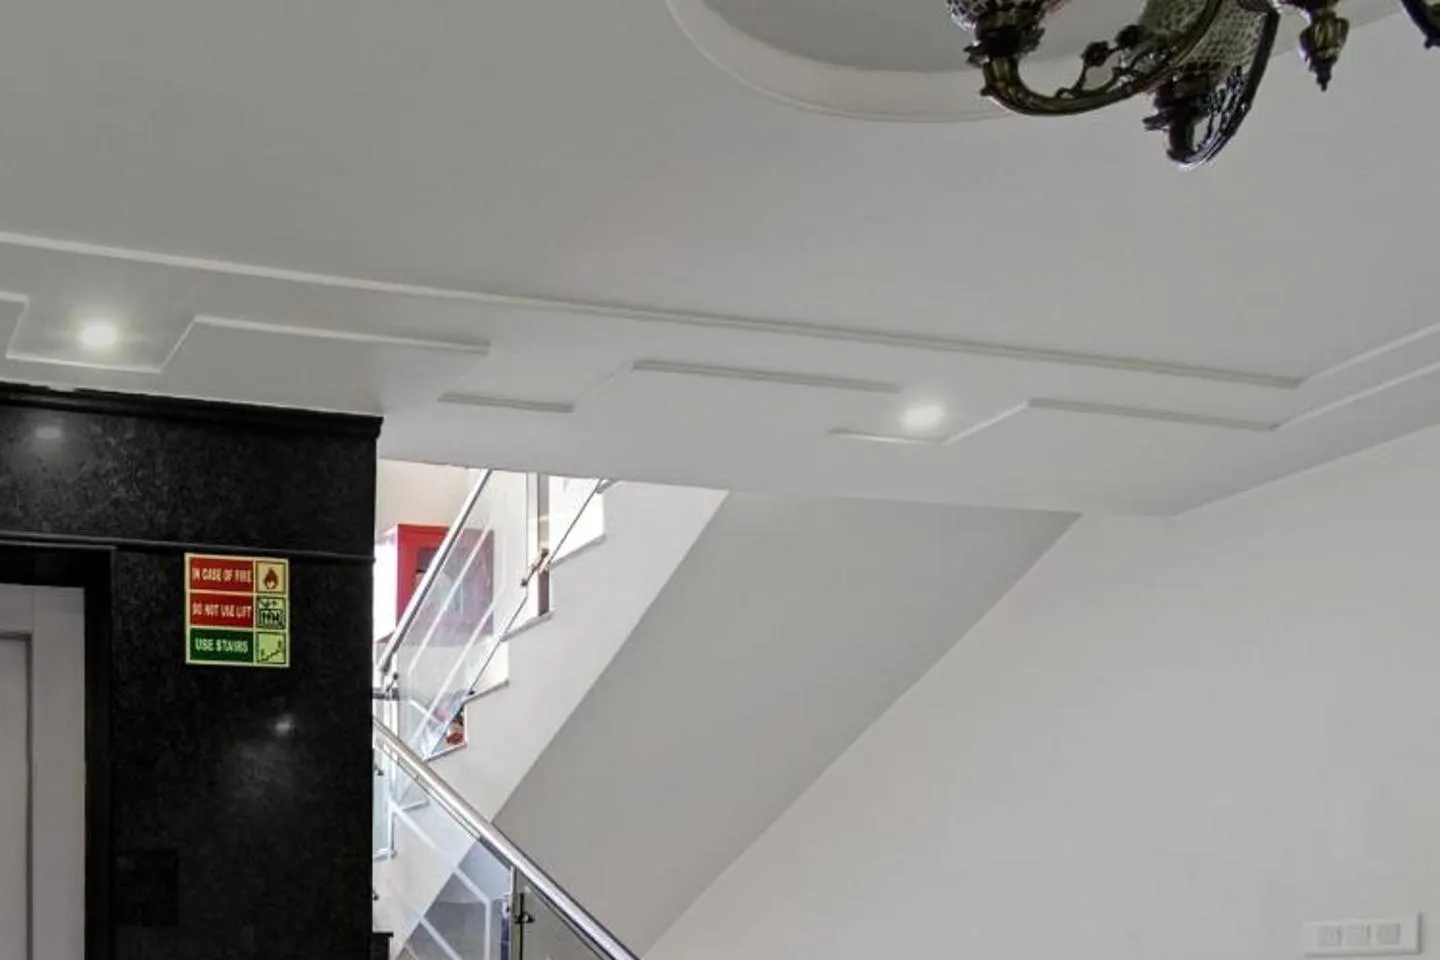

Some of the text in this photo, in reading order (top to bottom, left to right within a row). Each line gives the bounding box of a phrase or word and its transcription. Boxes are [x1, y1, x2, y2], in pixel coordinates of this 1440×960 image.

[202, 568, 222, 581] CASE
[223, 569, 233, 582] OF
[235, 569, 252, 583] FIRE
[192, 602, 252, 618] DO NOT USE LIFT
[195, 637, 249, 653] USE STAIRS
